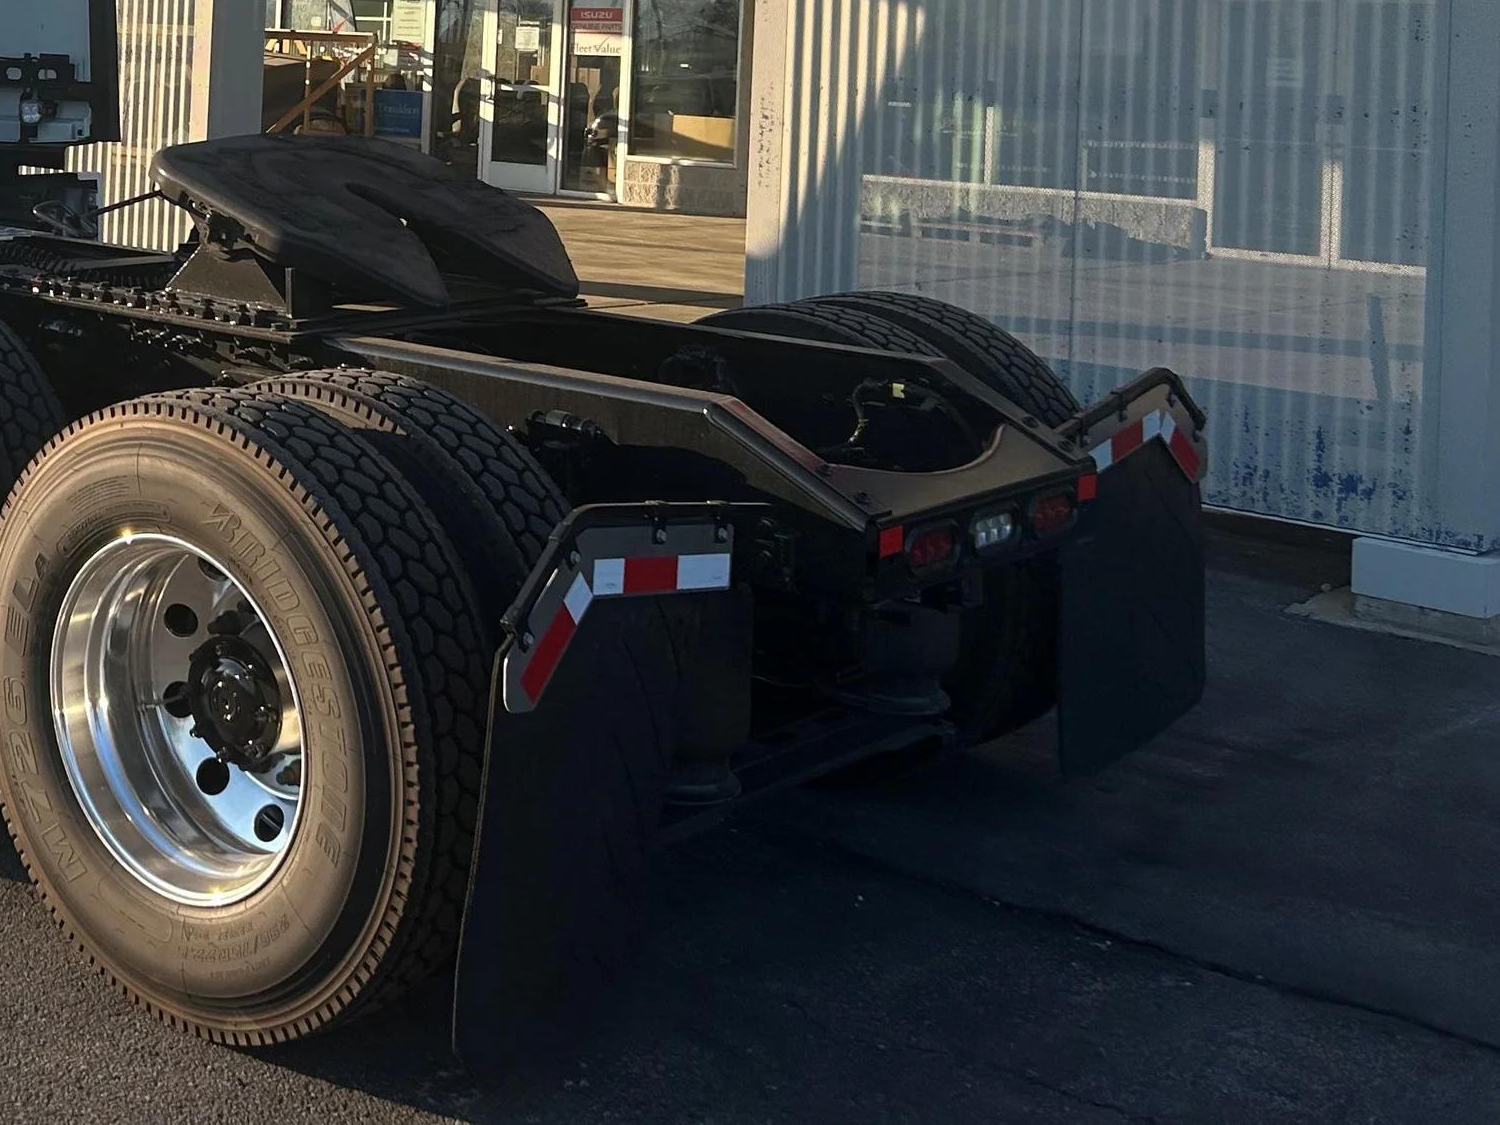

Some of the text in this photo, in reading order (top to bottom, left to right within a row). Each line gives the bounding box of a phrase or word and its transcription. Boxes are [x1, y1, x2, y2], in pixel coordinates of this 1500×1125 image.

[580, 11, 612, 19] ISUZU
[570, 39, 621, 54] Fleet Value
[378, 102, 420, 114] Donaldson
[202, 502, 348, 868] BRIDGESTONE
[3, 676, 88, 883] M726
